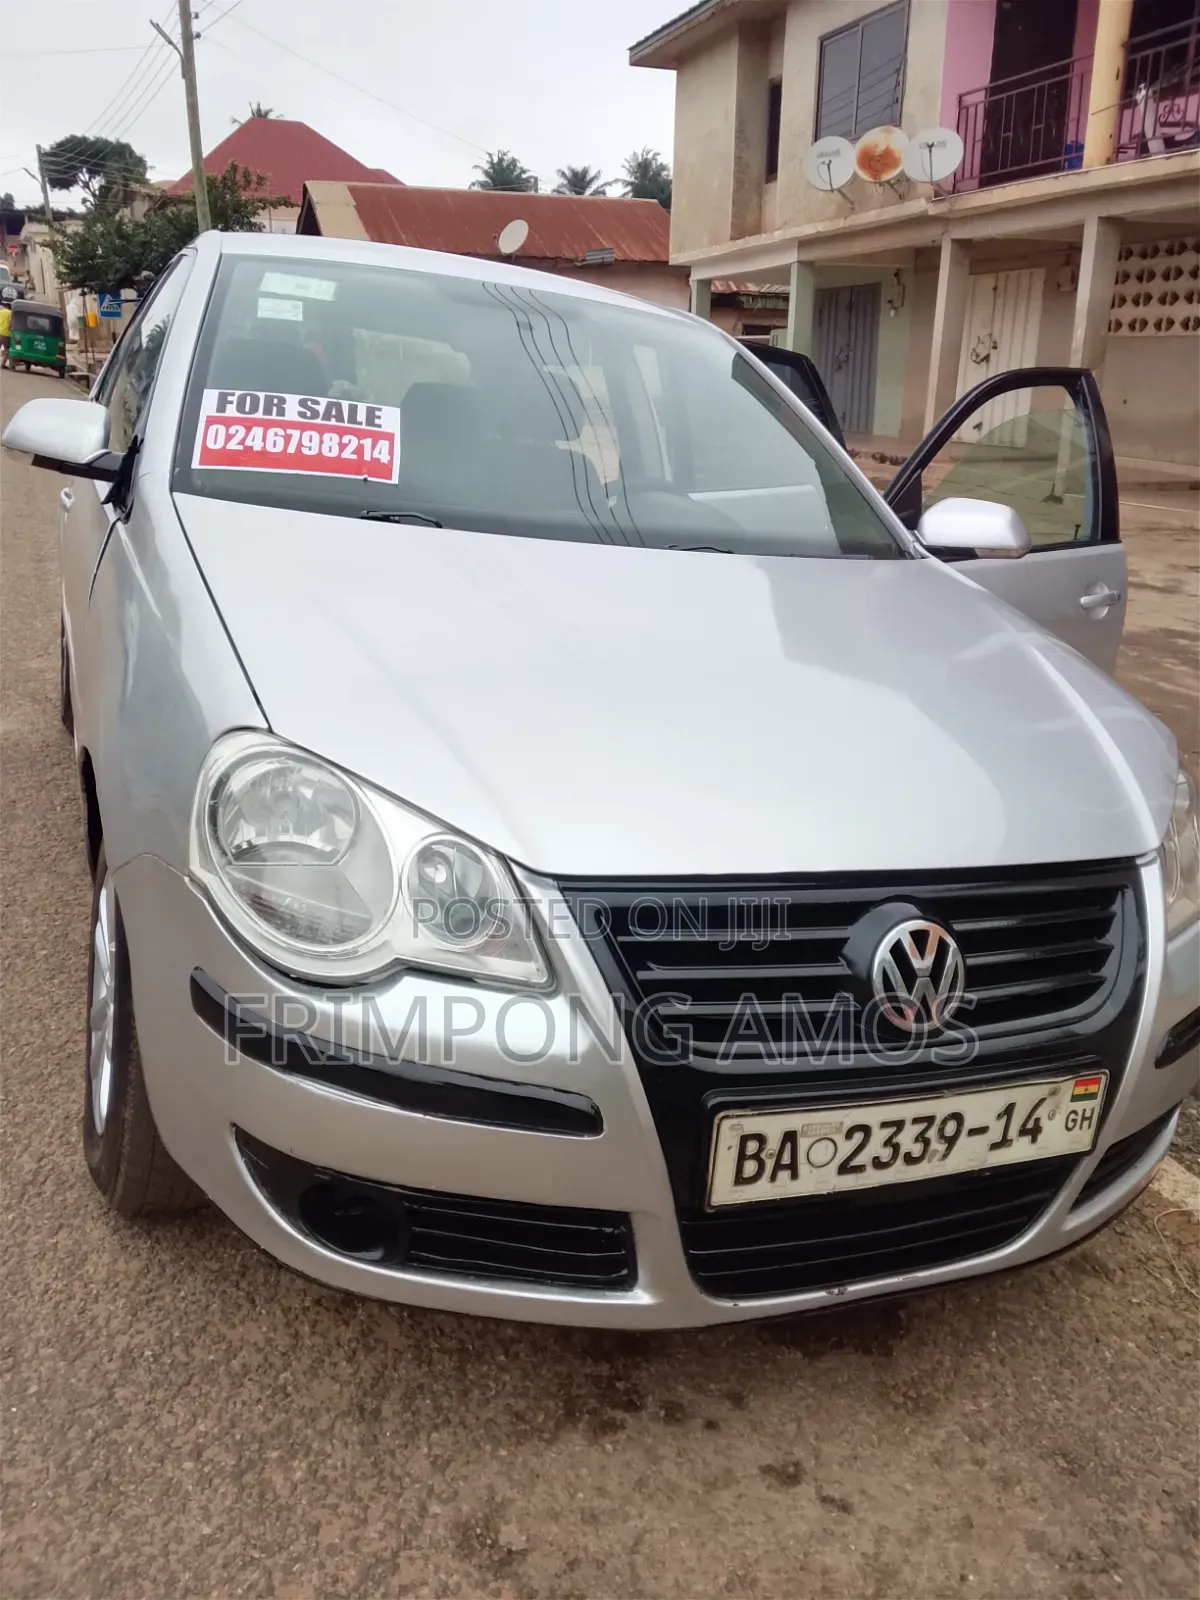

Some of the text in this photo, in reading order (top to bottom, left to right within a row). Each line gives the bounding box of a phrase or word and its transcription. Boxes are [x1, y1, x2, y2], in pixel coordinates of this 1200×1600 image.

[215, 391, 383, 428] FOR SALE
[206, 424, 391, 464] 0246798214
[733, 1097, 1094, 1187] BA 2339-14 GH
